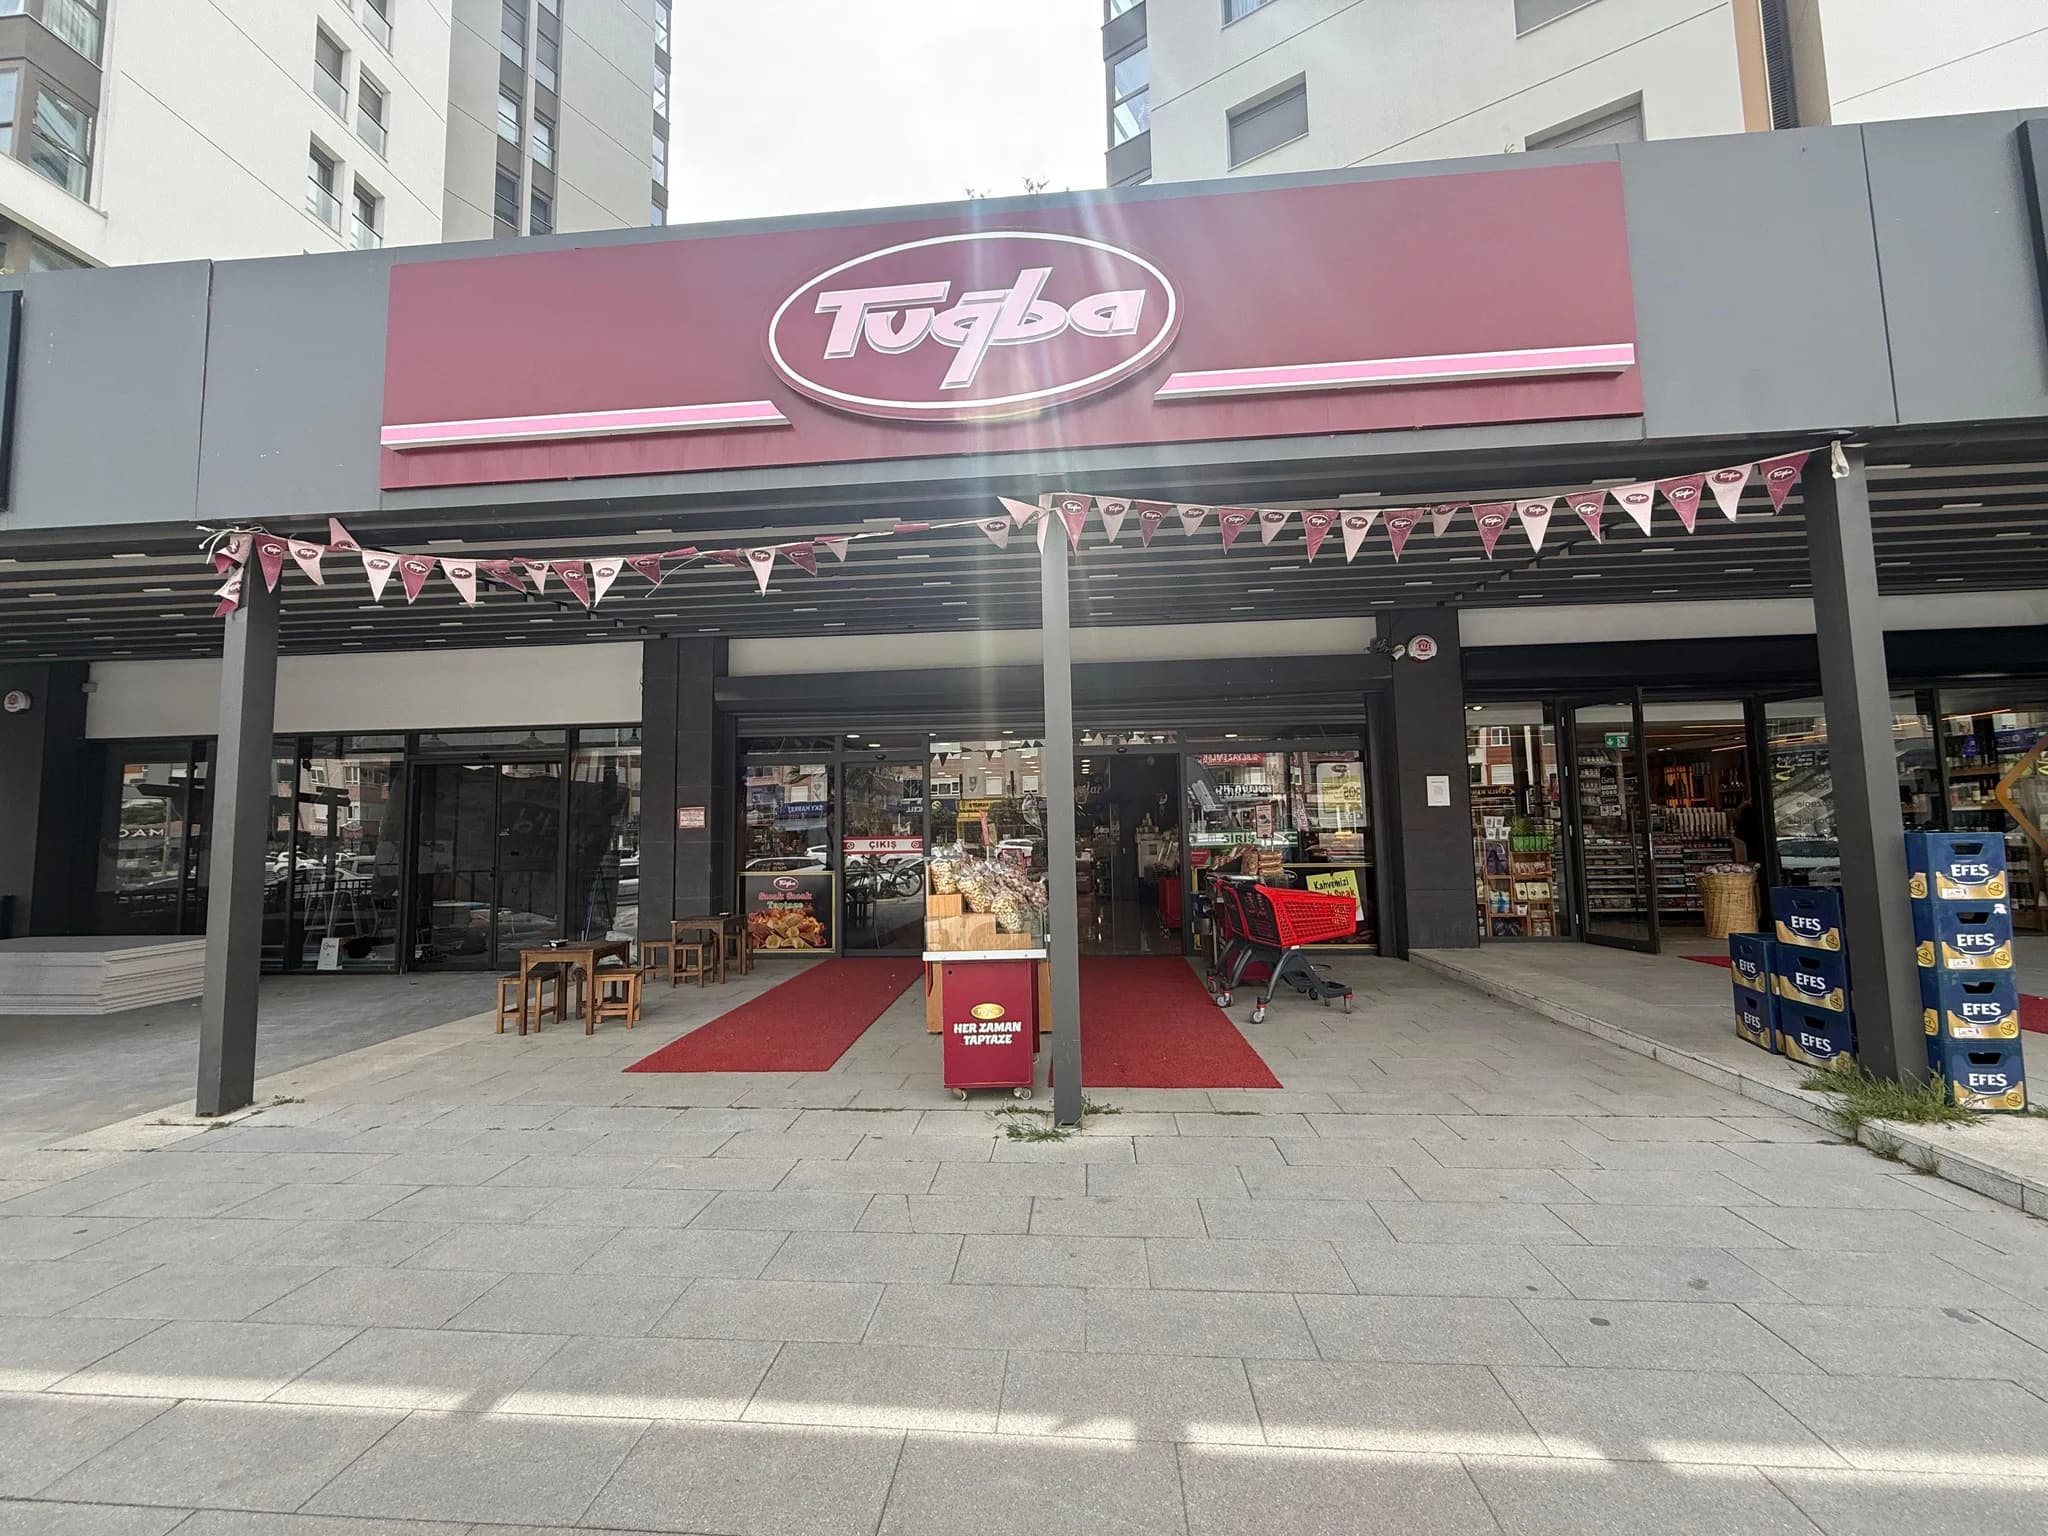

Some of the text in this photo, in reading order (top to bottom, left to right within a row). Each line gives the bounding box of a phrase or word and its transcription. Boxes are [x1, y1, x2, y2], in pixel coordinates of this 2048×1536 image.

[869, 841, 897, 850] ÇIKIŞ
[1951, 864, 1989, 877] EFES
[1791, 915, 1821, 931] EFES
[1956, 933, 1995, 947] EFES
[1739, 959, 1756, 974] EFES
[1796, 972, 1826, 989] EFES
[1962, 1002, 2001, 1016] EFES
[1744, 1012, 1760, 1028] EFES
[953, 1021, 1022, 1034] HER ZAMAN
[963, 1034, 1013, 1046] TAPTAZE
[1801, 1033, 1831, 1052] EFES
[1969, 1073, 2007, 1087] EFES
